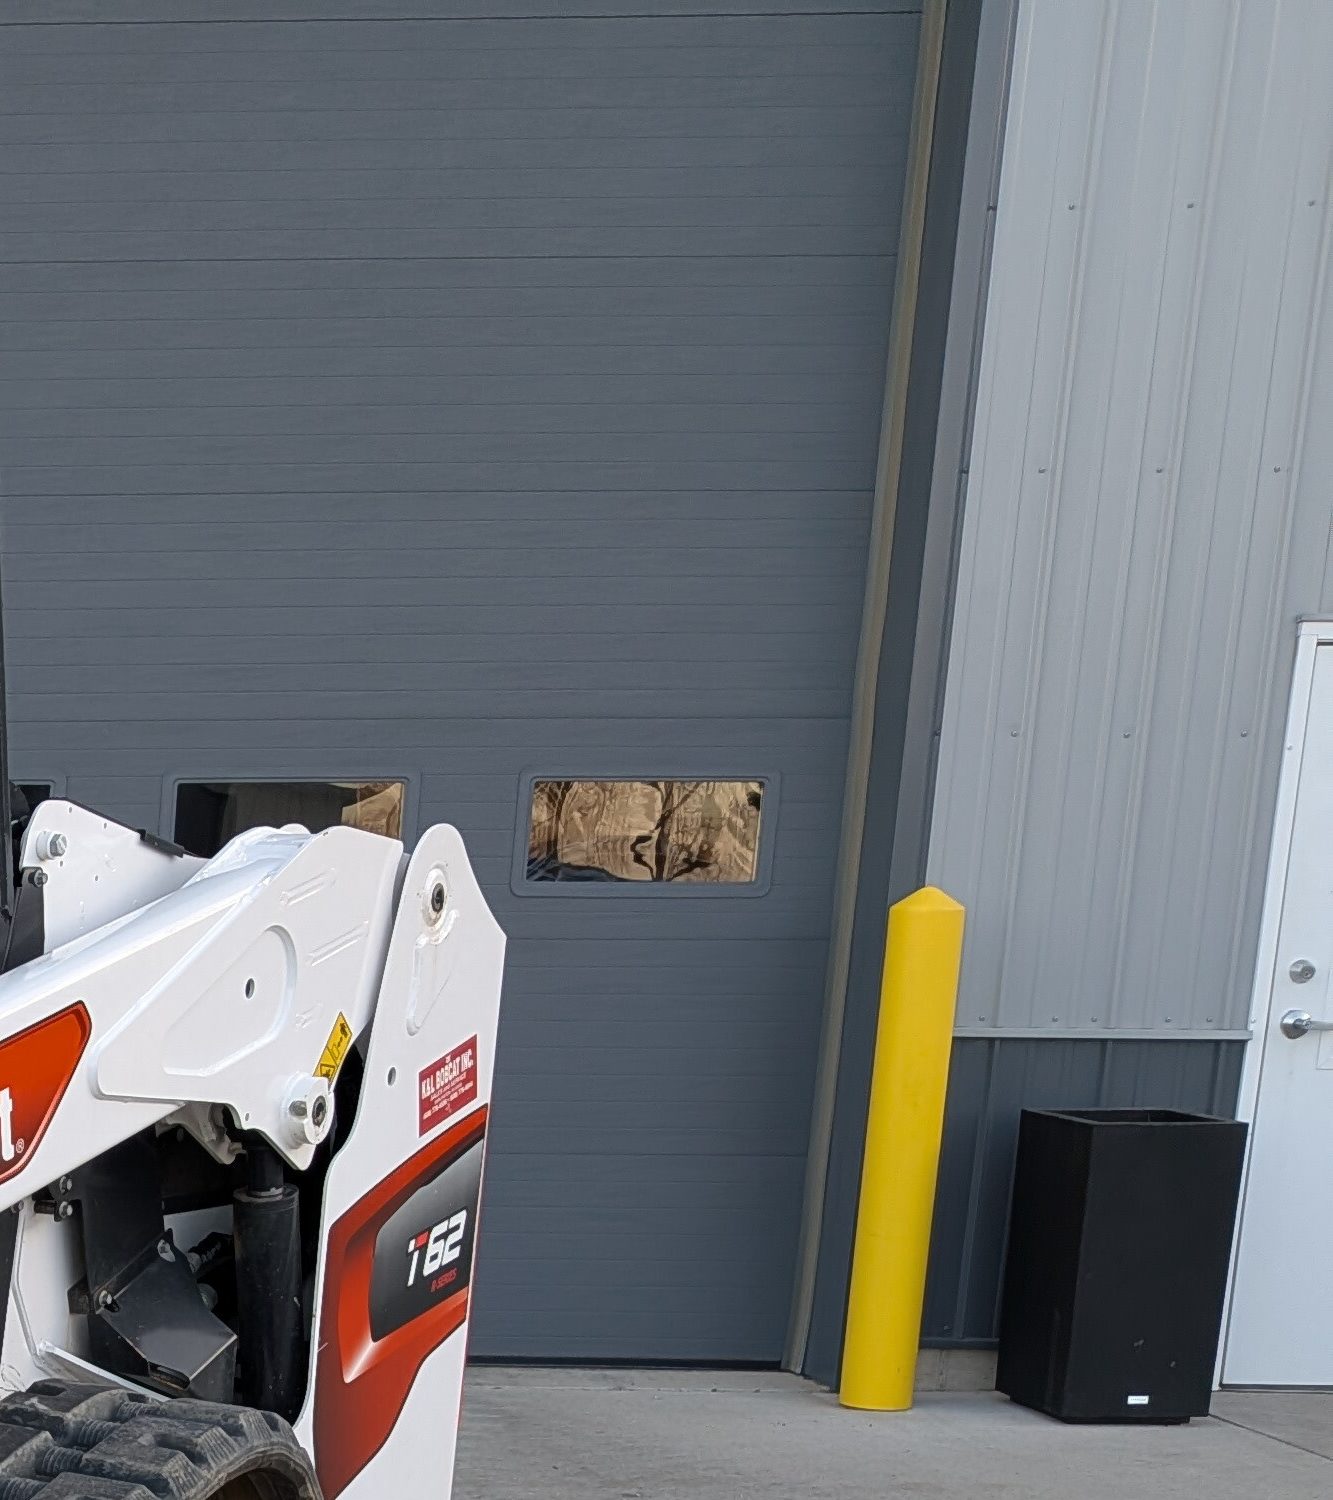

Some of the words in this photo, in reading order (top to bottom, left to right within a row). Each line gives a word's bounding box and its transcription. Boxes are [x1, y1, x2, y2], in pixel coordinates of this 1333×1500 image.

[421, 1075, 435, 1099] K&L
[436, 1056, 460, 1090] BOBCAT
[461, 1048, 474, 1072] INC.
[407, 1209, 467, 1287] T62
